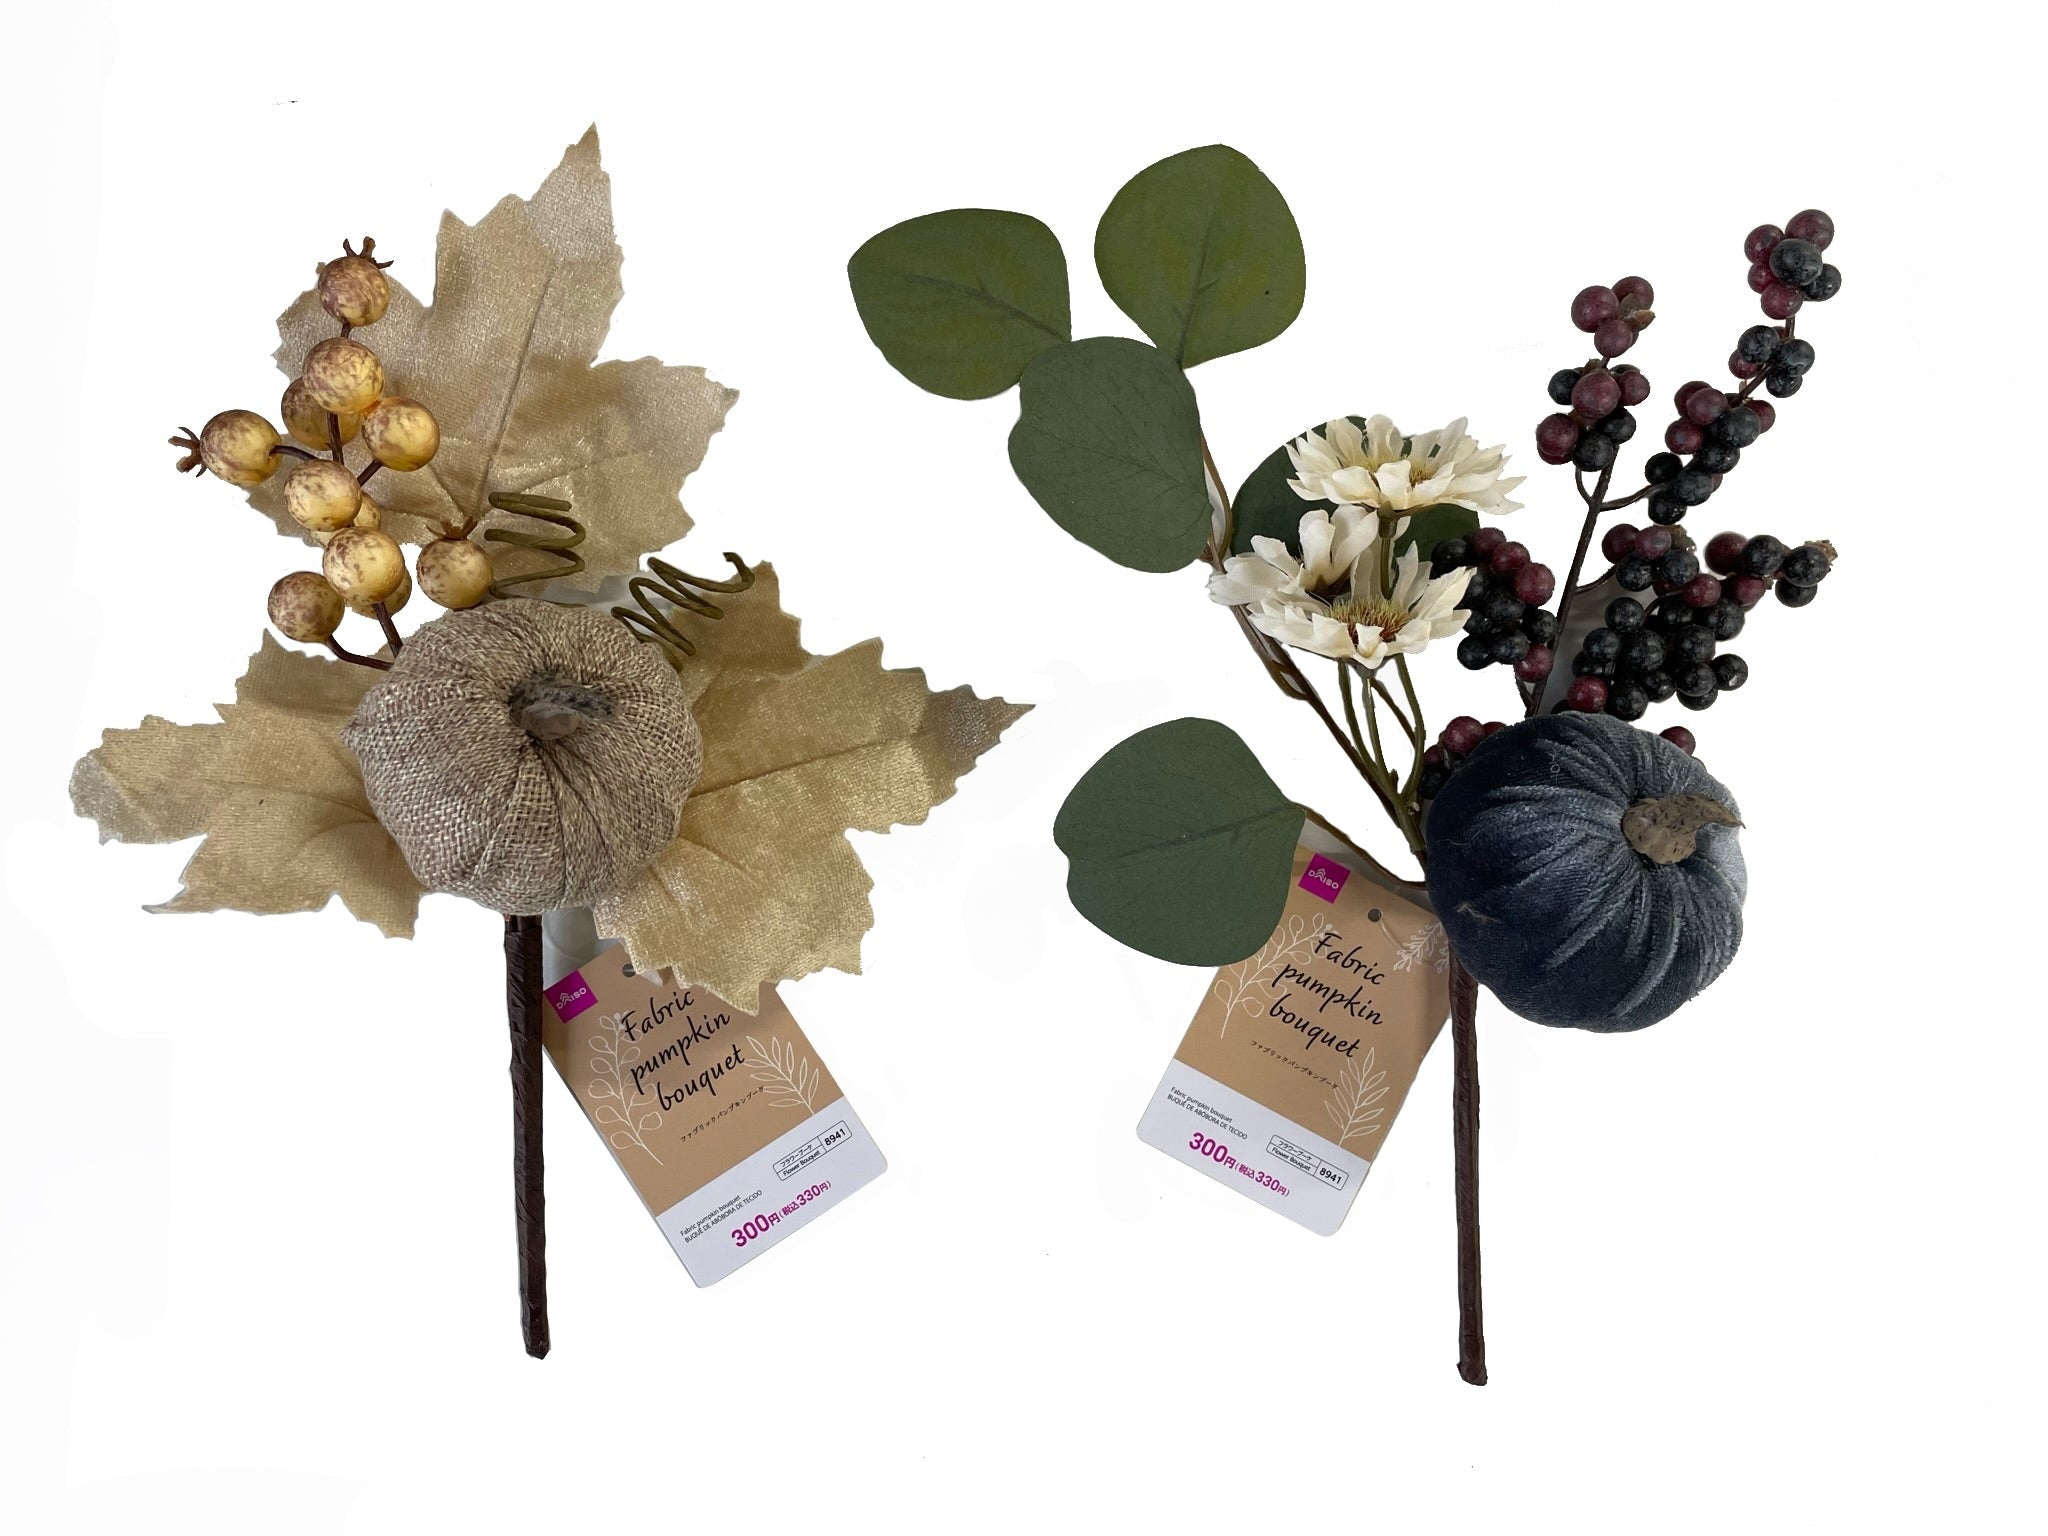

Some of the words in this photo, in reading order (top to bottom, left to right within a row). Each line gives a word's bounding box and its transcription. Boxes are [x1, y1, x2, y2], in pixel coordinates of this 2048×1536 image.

[1308, 868, 1339, 890] DAISO
[1314, 932, 1385, 985] Fabric
[556, 987, 587, 1010] DAISO
[1271, 963, 1384, 1026] pumpkin
[621, 990, 695, 1041] Fabric
[1269, 993, 1361, 1058] bouquet
[630, 1013, 731, 1095] pumpkin
[657, 1044, 746, 1112] bouquet
[1170, 1086, 1187, 1099] Fabric
[1186, 1096, 1210, 1112] pumpkin
[1210, 1107, 1233, 1123] bouquet
[1186, 1103, 1195, 1112] DE
[1219, 1121, 1229, 1130] DE
[1228, 1125, 1248, 1140] TECIDO
[825, 1128, 846, 1146] 8941
[1278, 1140, 1312, 1161] フラワーブーケ
[780, 1144, 813, 1168] フラワーブーケ
[782, 1163, 800, 1177] Flower
[799, 1150, 821, 1166] Bouquet
[1271, 1146, 1290, 1160] Flower
[1289, 1156, 1311, 1171] Bouquet
[1319, 1167, 1342, 1184] 8941
[679, 1223, 697, 1237] Fabric
[696, 1209, 720, 1227] pumpkin
[718, 1195, 741, 1212] bouquet
[684, 1227, 704, 1243] BUQUÊ
[702, 1223, 712, 1232] DE
[735, 1202, 744, 1210] DE
[743, 1189, 763, 1205] TECIDO
